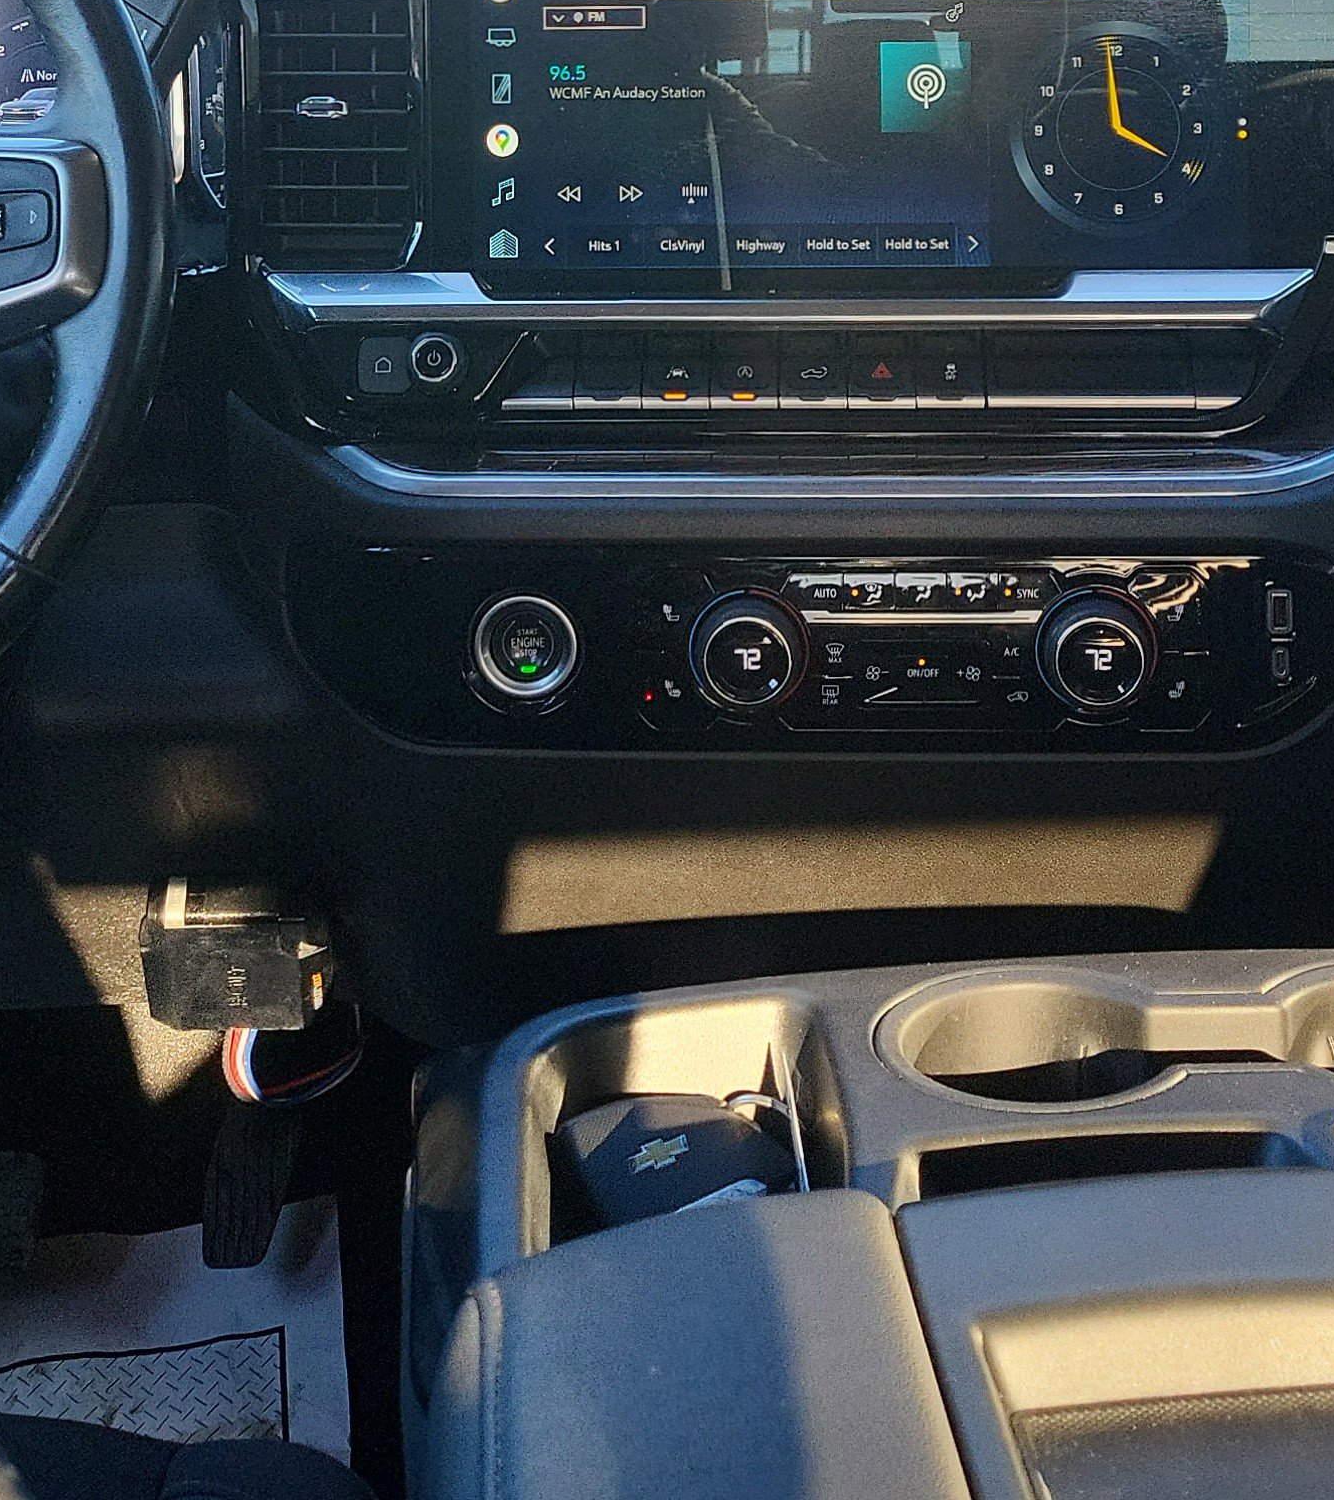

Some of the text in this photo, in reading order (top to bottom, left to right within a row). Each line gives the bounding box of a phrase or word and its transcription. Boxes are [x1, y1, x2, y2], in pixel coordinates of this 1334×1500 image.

[588, 12, 606, 22] FM
[1110, 46, 1123, 56] 12
[1071, 57, 1082, 67] 11
[1153, 56, 1159, 67] 1
[36, 70, 57, 81] Nor
[548, 64, 586, 81] 96.5
[549, 86, 706, 102] WCMF An Audacy Station
[1040, 86, 1054, 97] 10
[1182, 85, 1192, 96] 2
[1034, 125, 1043, 137] 9
[1193, 123, 1202, 134] 3
[1044, 165, 1054, 176] 8
[1181, 163, 1191, 174] 4
[1074, 193, 1083, 204] 7
[1154, 192, 1164, 203] 5
[1114, 204, 1124, 215] 6
[588, 240, 620, 252] Hits 1
[660, 239, 704, 253] ClsVinyl
[736, 239, 785, 254] Highway
[807, 239, 870, 251] Hold to Set
[885, 238, 949, 250] Hold to Set
[813, 588, 837, 598] AUTO
[1016, 588, 1040, 599] SYNC
[516, 628, 538, 636] START
[510, 637, 545, 649] ENGINE
[520, 649, 538, 657] STOP
[1003, 647, 1020, 656] A/C
[734, 648, 762, 671] 72
[1085, 649, 1113, 671] 72
[907, 668, 940, 678] ON/OFF
